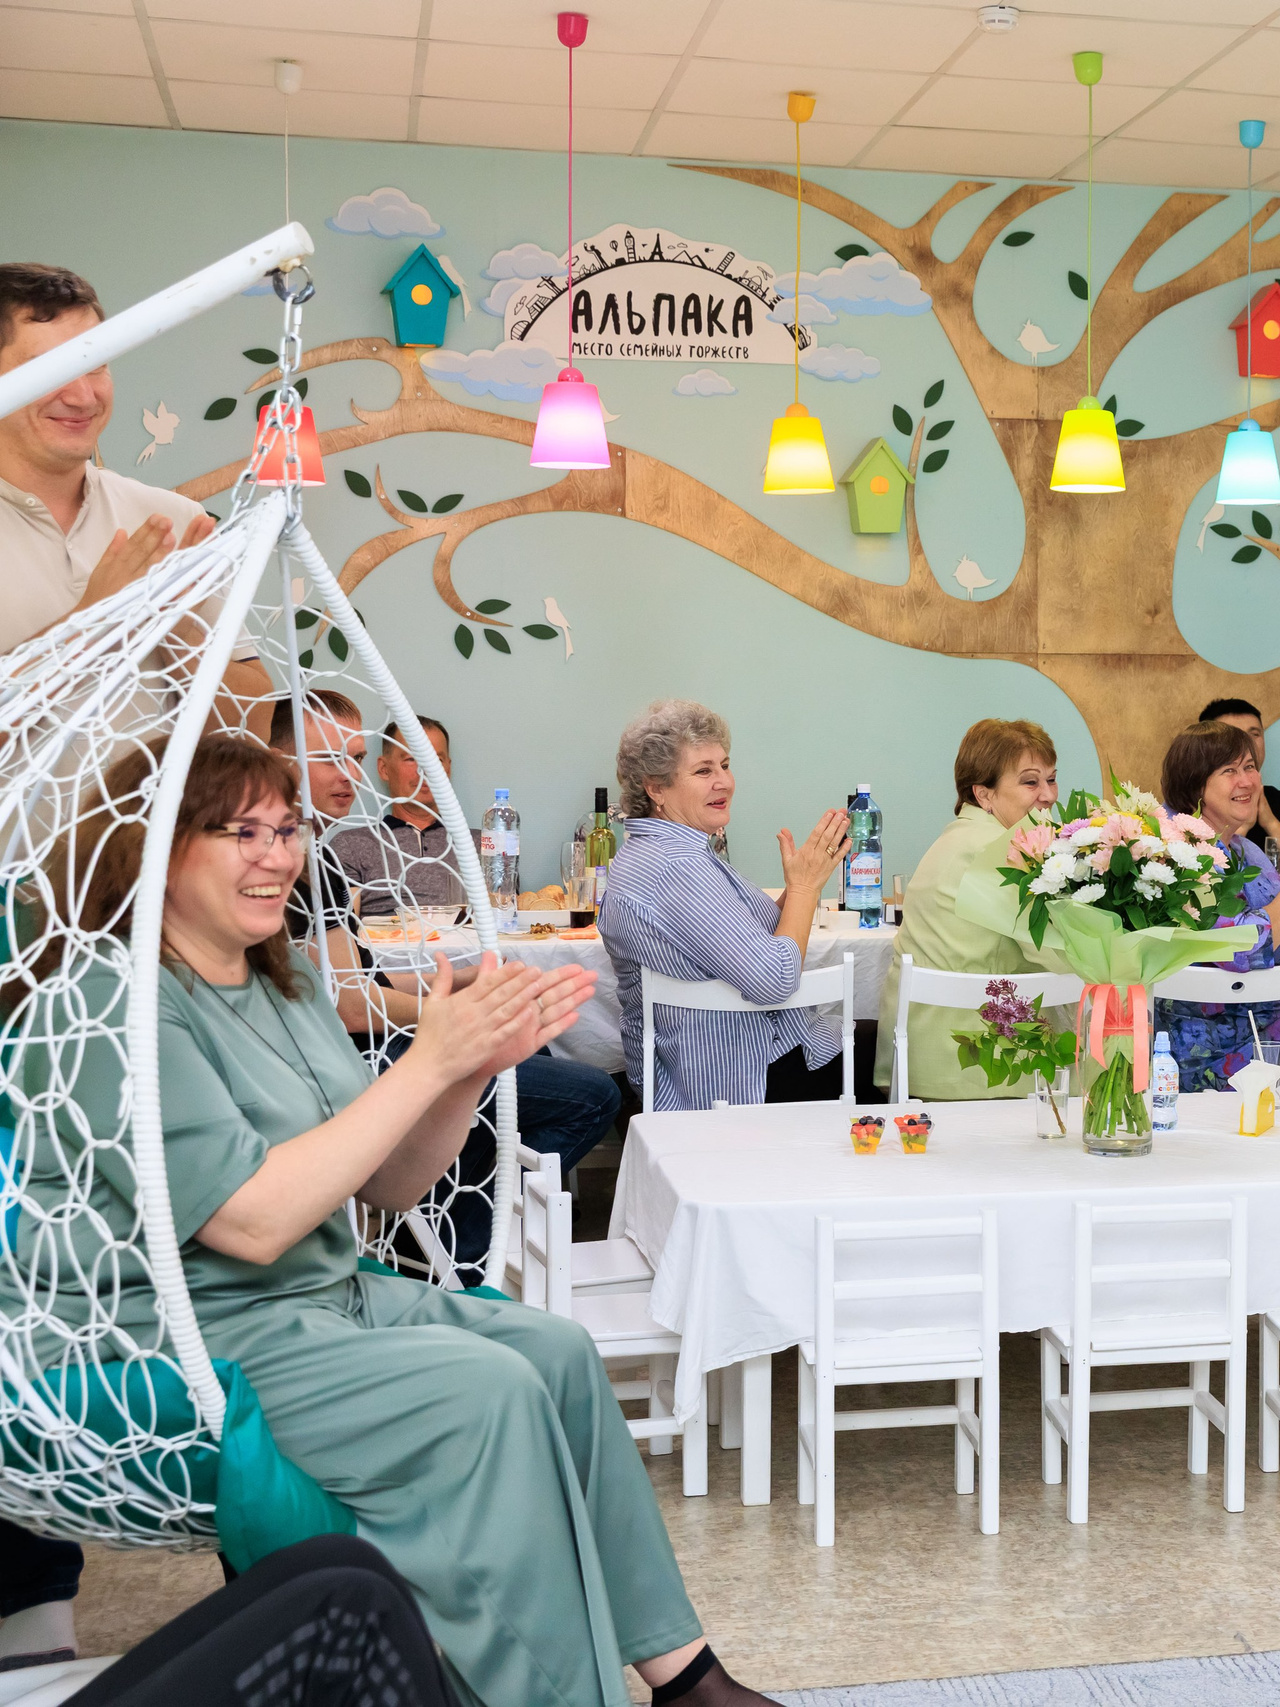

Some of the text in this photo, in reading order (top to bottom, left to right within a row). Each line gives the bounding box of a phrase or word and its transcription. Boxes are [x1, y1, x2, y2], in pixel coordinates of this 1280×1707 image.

[571, 289, 753, 338] АЛЬПАКА
[571, 342, 749, 359] МЕСТО СЕМЕЙНЫХ ТОРЖЕСТВ
